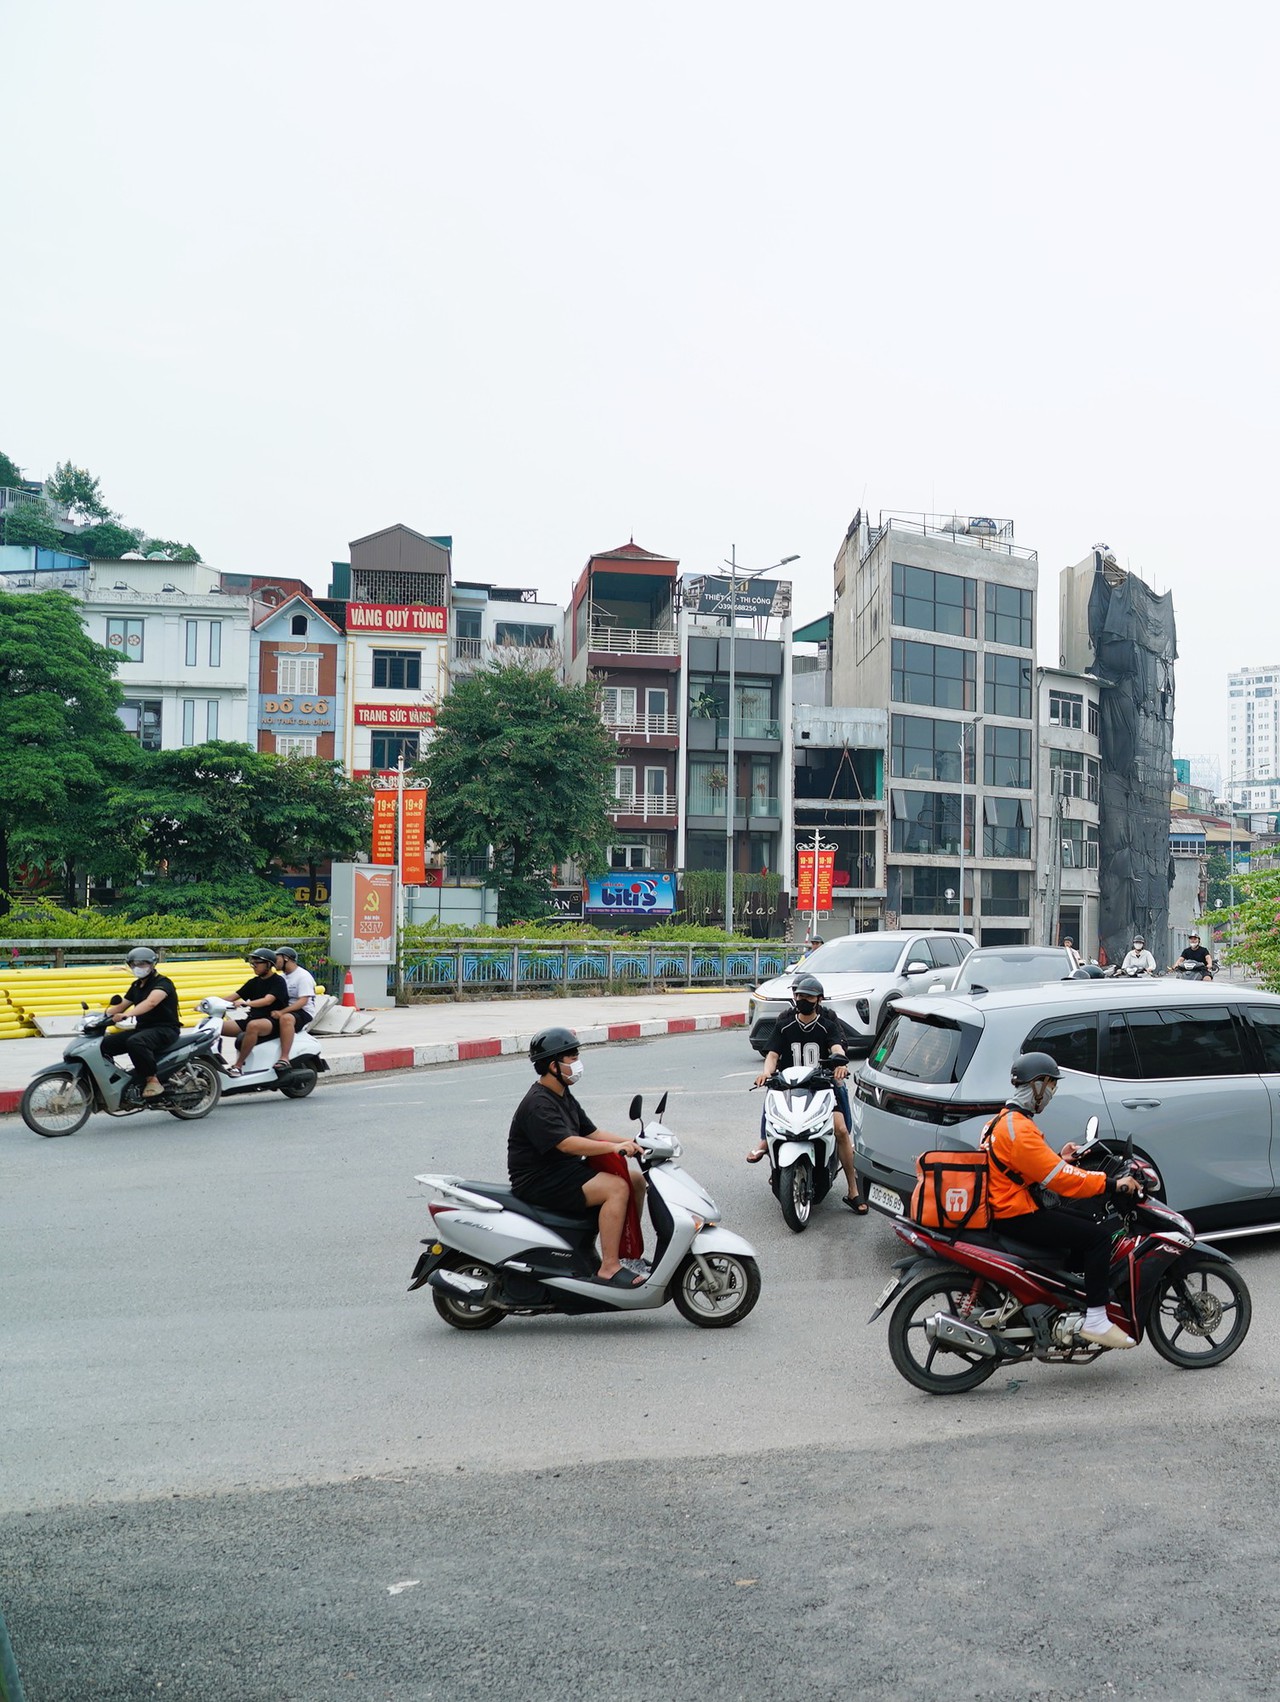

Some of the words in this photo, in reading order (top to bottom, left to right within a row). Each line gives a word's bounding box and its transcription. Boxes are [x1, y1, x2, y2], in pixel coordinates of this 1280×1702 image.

[718, 603, 757, 612] 039688256
[751, 596, 771, 605] CÔNG
[351, 606, 382, 627] VÀNG
[385, 606, 409, 629] QUÝ
[412, 608, 444, 629] TÙNG
[265, 697, 294, 713] ĐỒ
[300, 698, 329, 714] GỖ
[359, 709, 387, 722] TRANG
[390, 708, 407, 722] SỨC
[409, 709, 432, 723] VÀNG
[359, 921, 383, 933] XIV
[791, 1042, 820, 1067] 10
